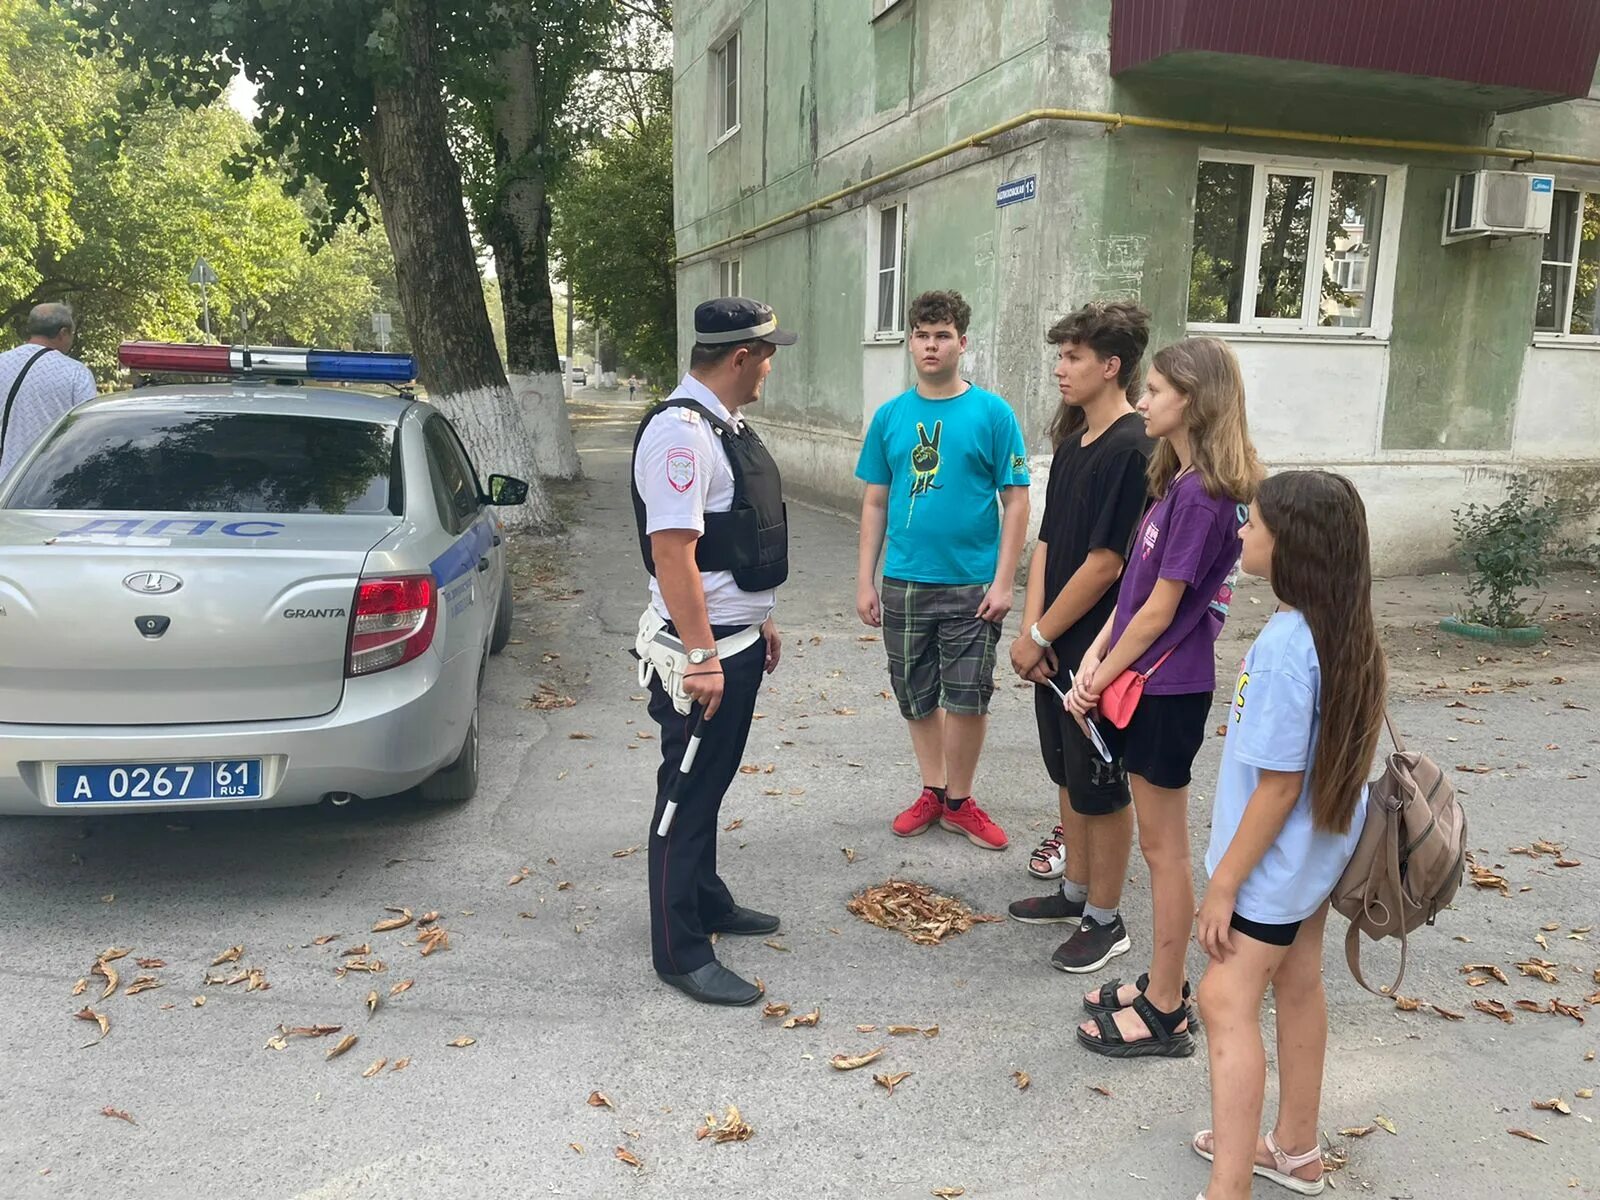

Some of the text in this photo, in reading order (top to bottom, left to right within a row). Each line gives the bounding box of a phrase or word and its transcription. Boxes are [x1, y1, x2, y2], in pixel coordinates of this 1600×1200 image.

[1025, 180, 1034, 193] 13
[58, 519, 286, 537] ДПС
[283, 608, 346, 619] GRANTA
[108, 766, 194, 798] 0267
[216, 763, 248, 786] 61
[220, 786, 245, 795] RUS
